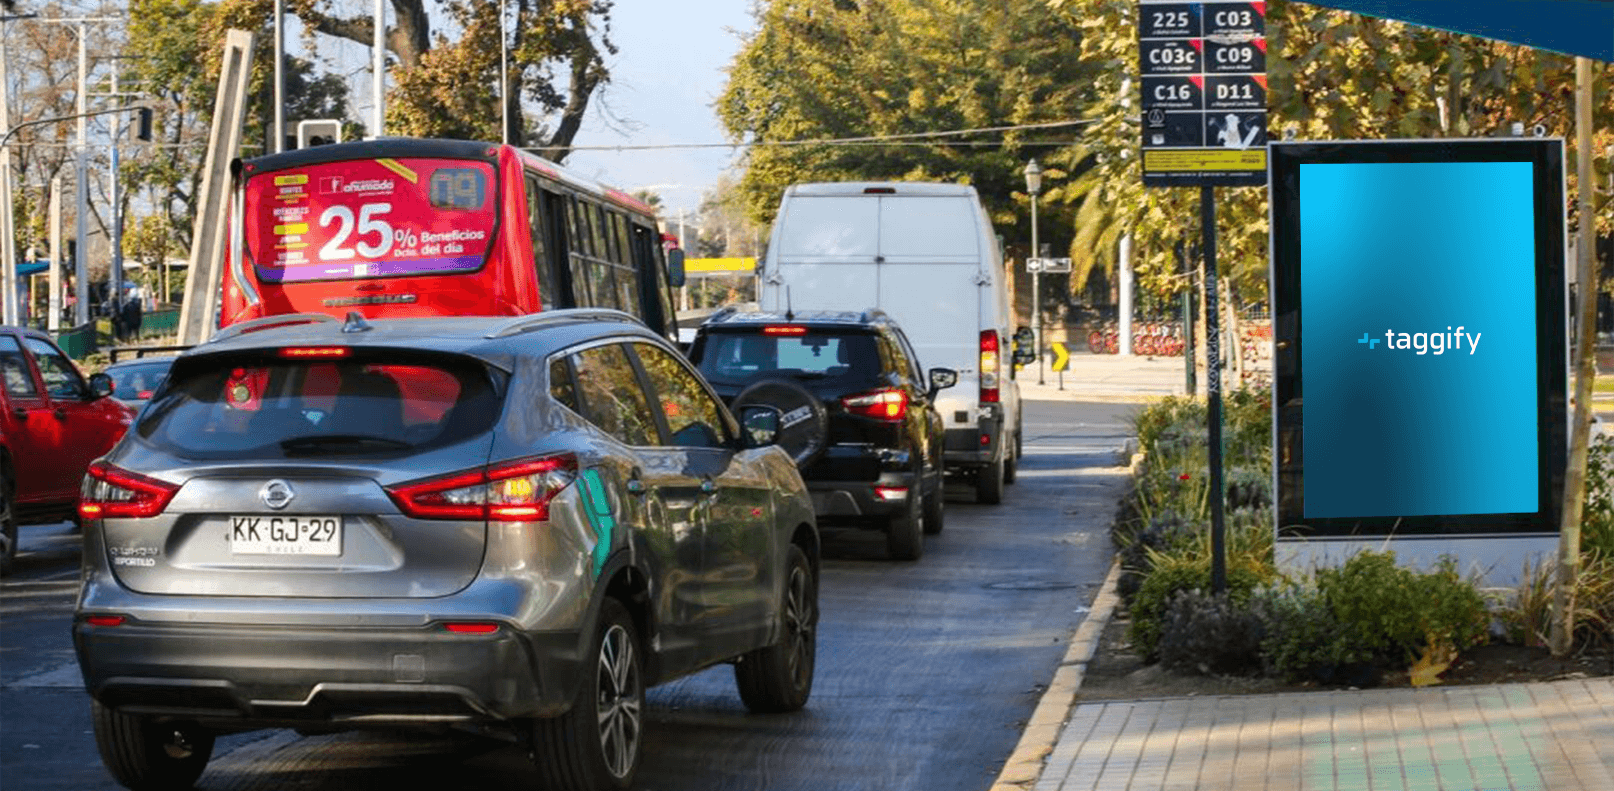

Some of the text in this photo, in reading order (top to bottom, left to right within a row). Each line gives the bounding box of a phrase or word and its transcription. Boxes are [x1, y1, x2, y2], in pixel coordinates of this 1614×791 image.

[1153, 12, 1189, 27] 225
[1215, 11, 1252, 26] C03
[1149, 48, 1196, 64] C03c
[1216, 47, 1253, 62] C09
[1154, 84, 1191, 100] C16
[1217, 84, 1254, 99] D11
[421, 230, 485, 243] Beneficios
[421, 244, 441, 255] del
[1385, 326, 1482, 355] taggify
